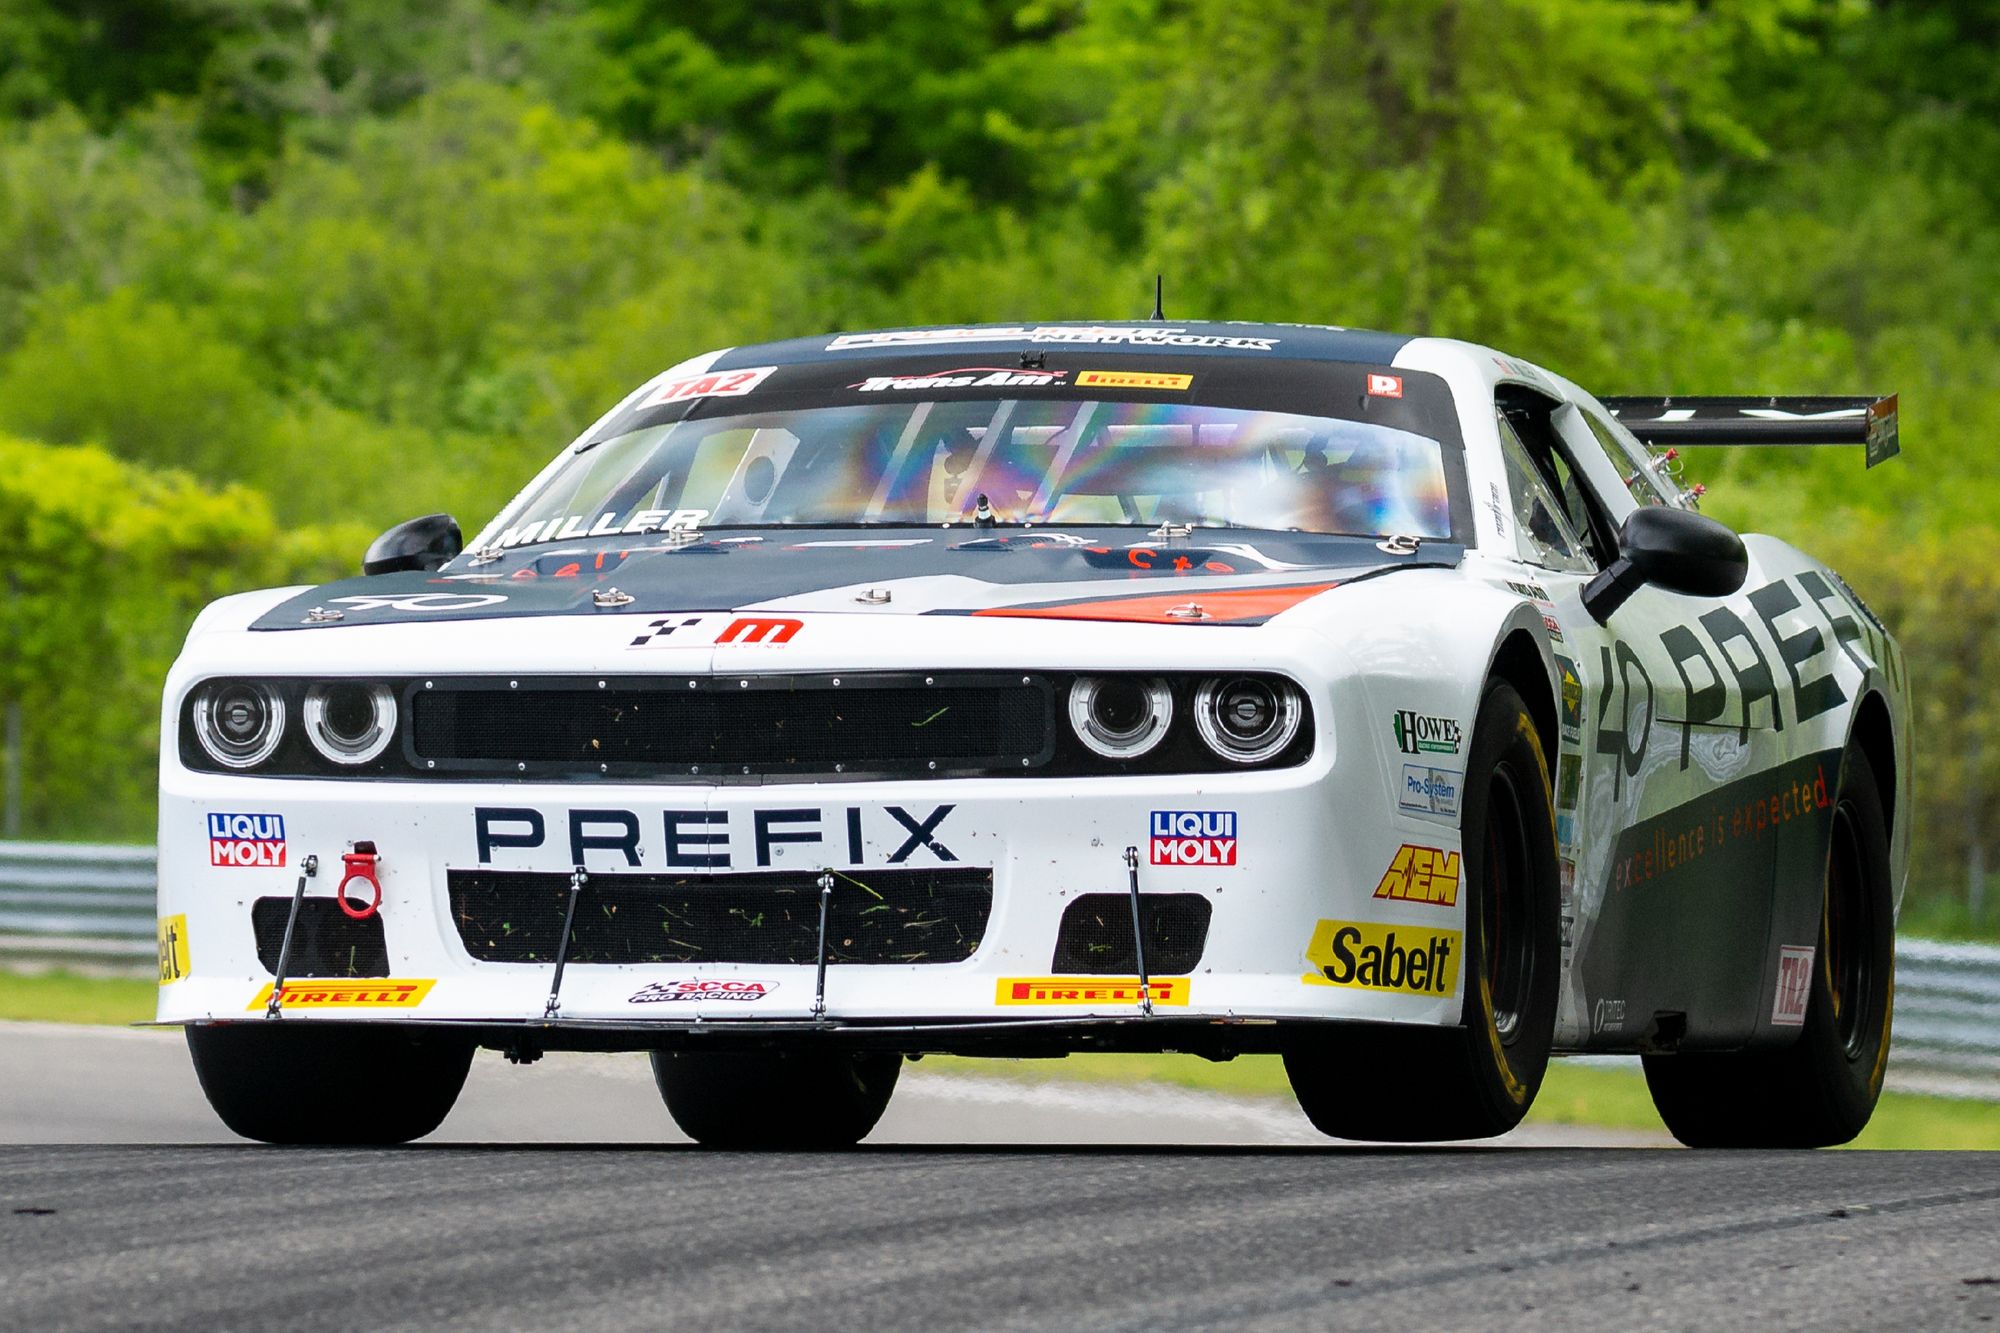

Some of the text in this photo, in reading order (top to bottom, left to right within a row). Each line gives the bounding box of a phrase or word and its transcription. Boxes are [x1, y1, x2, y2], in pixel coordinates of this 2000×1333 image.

[1033, 331, 1280, 350] NETWORK
[659, 372, 758, 400] TA2
[858, 372, 1053, 391] Trans Am
[1087, 374, 1181, 386] PIRELLI
[489, 509, 709, 549] MILLER
[1597, 639, 1653, 803] 40
[1408, 775, 1454, 800] Pro-System
[210, 814, 284, 839] LIQUI
[474, 803, 960, 867] PREFIX
[1154, 812, 1234, 838] LIQUI
[212, 840, 285, 866] MOLY
[1154, 839, 1236, 865] MOLY
[1615, 825, 1704, 892] excellence
[1710, 805, 1725, 849] is
[1372, 844, 1460, 906] AEM
[1323, 926, 1451, 992] Sabelt
[265, 985, 418, 1004] PIRELLI
[631, 991, 760, 1003] PRO RACING
[677, 981, 766, 993] SCCA
[1012, 982, 1173, 1000] PIRELLI
[1778, 957, 1809, 1015] TA2
